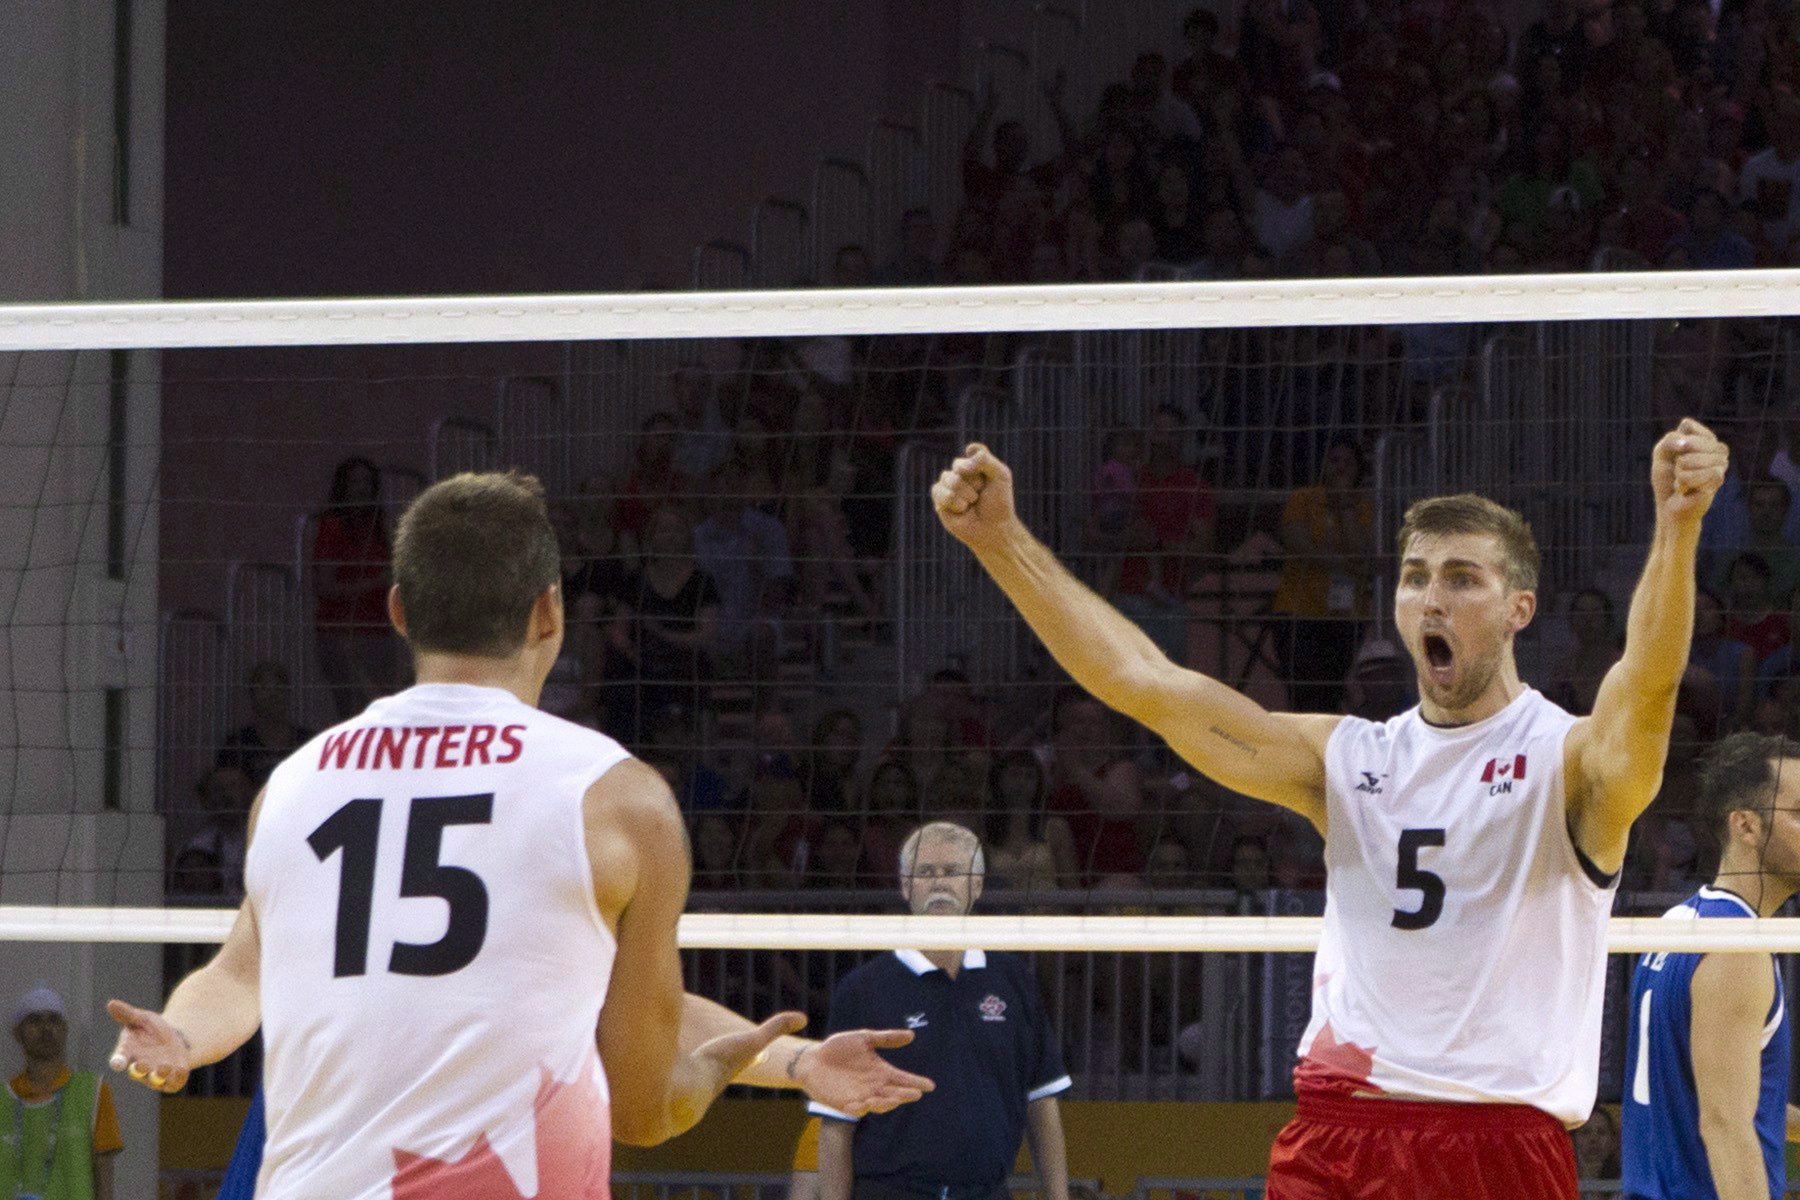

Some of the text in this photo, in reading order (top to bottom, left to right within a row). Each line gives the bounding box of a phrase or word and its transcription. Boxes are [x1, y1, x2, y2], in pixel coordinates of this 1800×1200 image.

[317, 725, 527, 771] WINTERS
[1489, 782, 1513, 797] CAN
[306, 792, 495, 978] 15
[1391, 828, 1446, 931] 5
